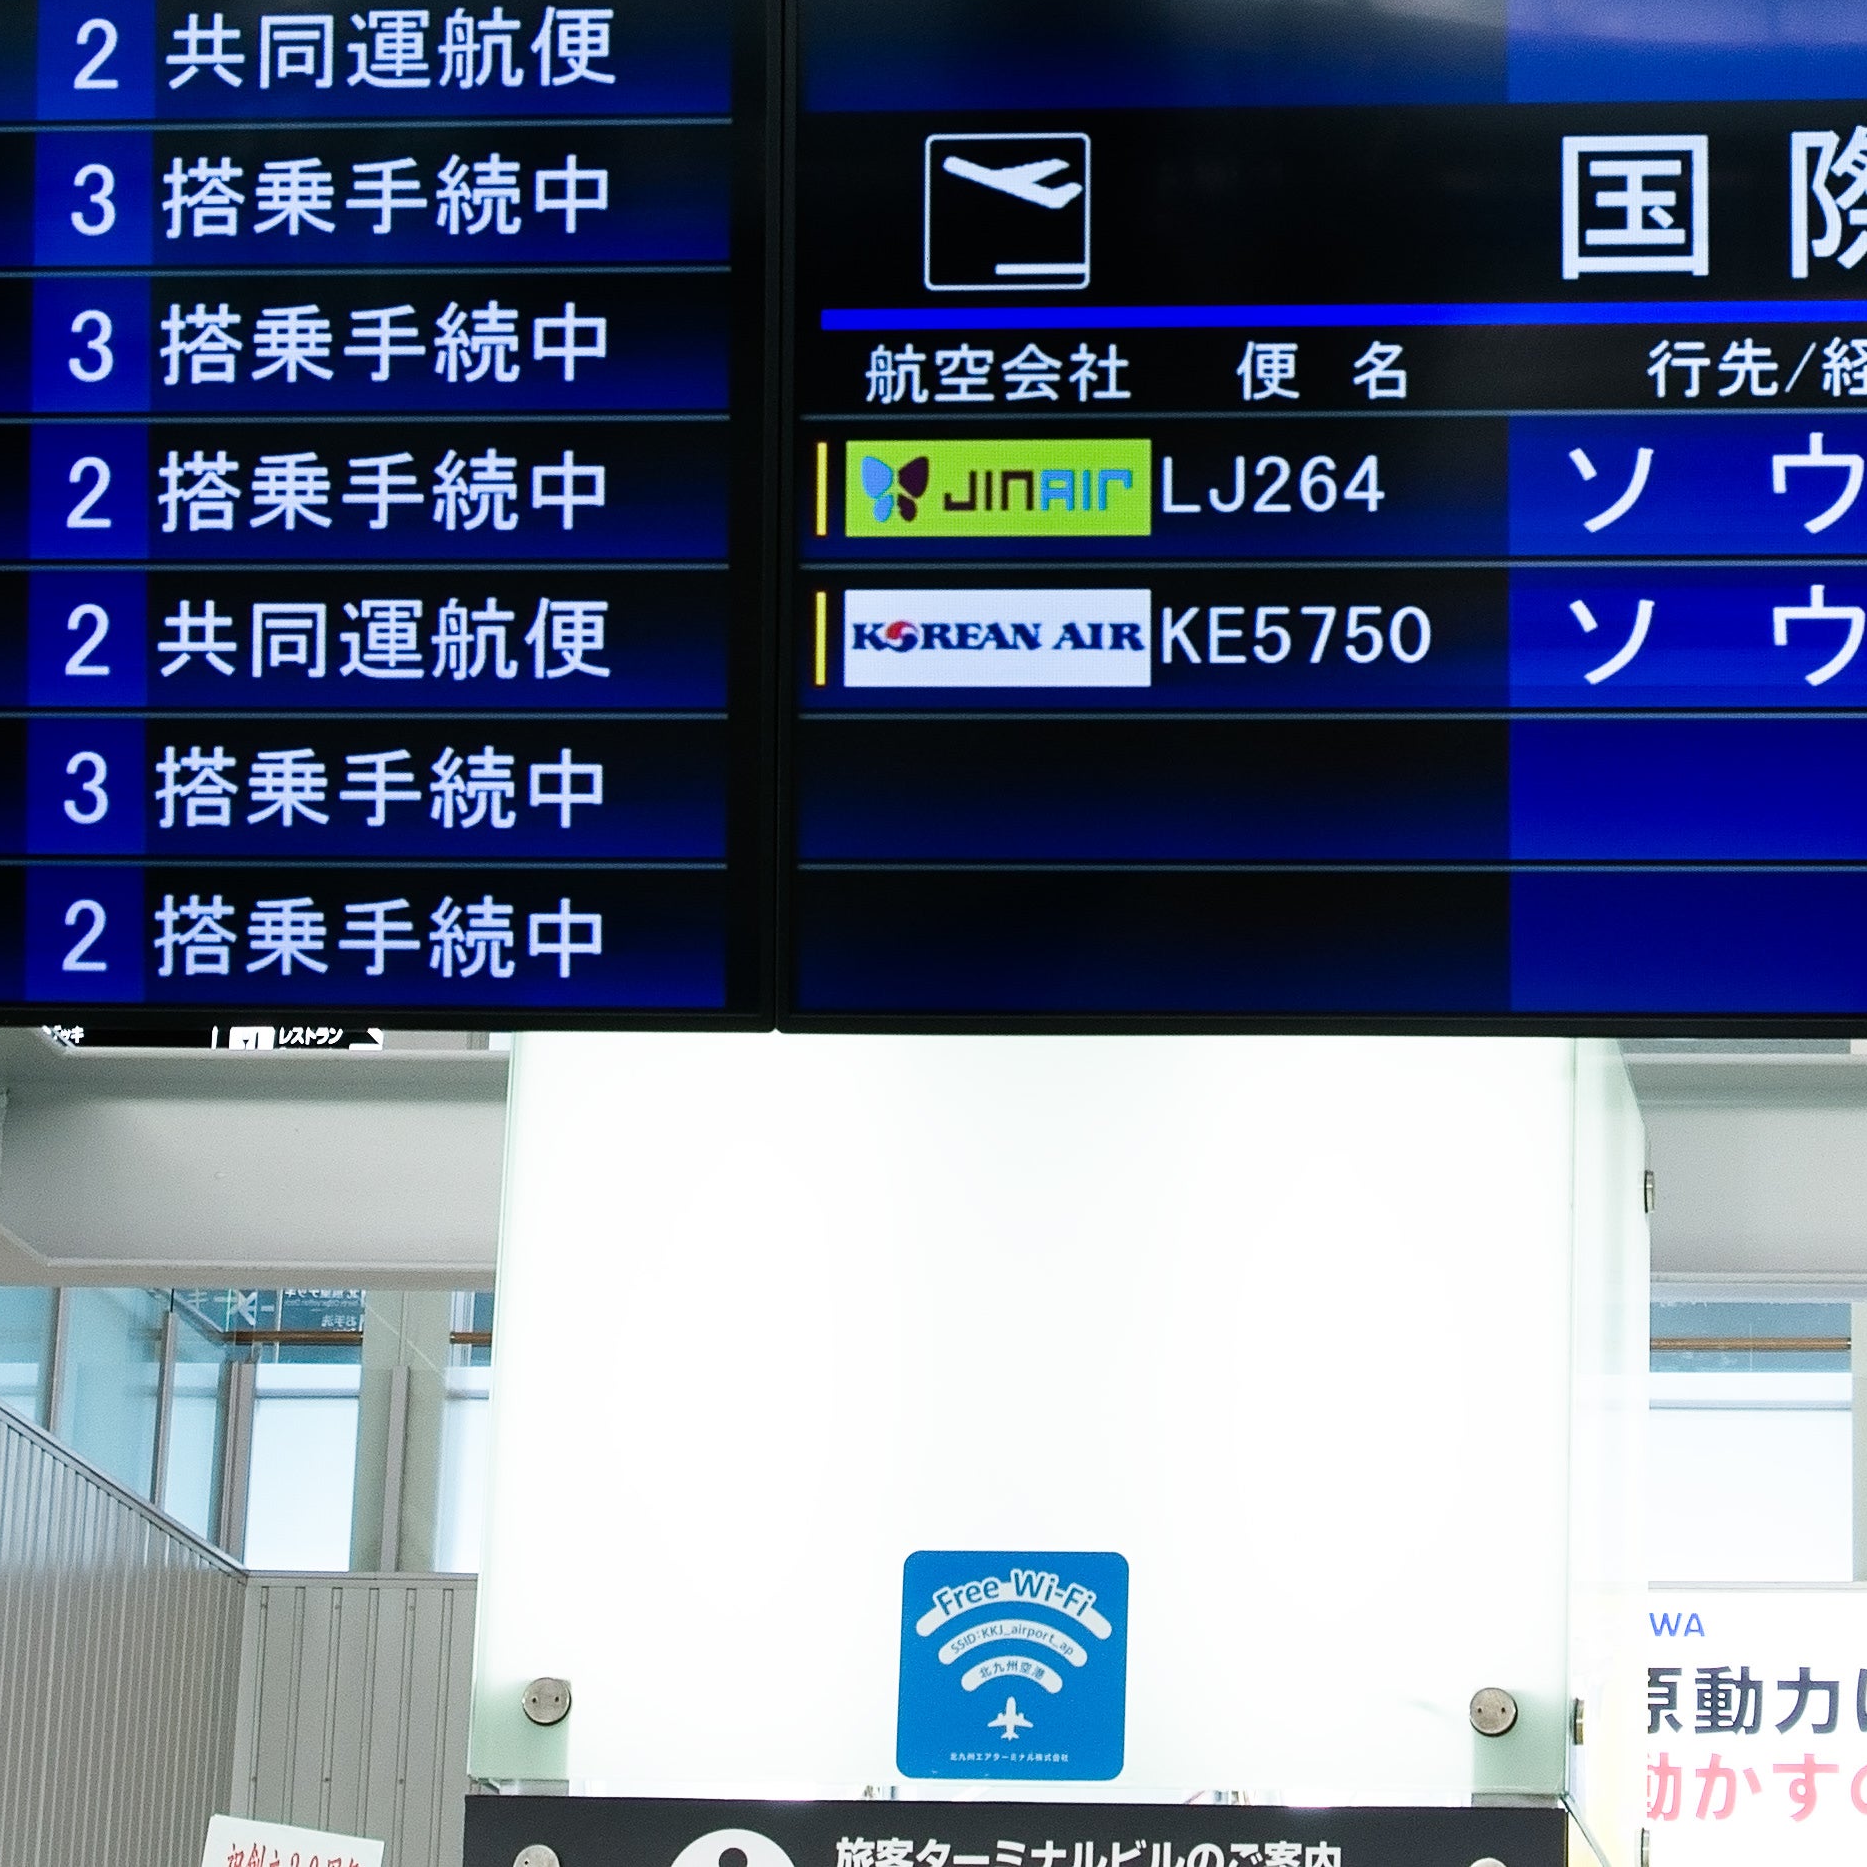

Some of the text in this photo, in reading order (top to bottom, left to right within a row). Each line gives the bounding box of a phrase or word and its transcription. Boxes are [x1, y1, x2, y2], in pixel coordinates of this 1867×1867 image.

[73, 18, 119, 89] 2
[166, 6, 616, 89] 共同運航便
[71, 163, 116, 236] 3
[162, 152, 608, 239] 搭乗手続中
[68, 309, 113, 382] 3
[160, 300, 607, 385] 搭乗手続中
[865, 342, 1131, 404] 航空会社
[1237, 340, 1407, 401] 便名
[66, 456, 111, 528] 2
[158, 448, 605, 533] 搭乗手続中
[1163, 455, 1385, 513] LJ264
[65, 603, 110, 676] 2
[157, 597, 610, 681] 共同運航便
[851, 620, 1041, 654] KOREAN
[1055, 622, 1145, 652] AIR
[1163, 606, 1431, 664] KE5750
[64, 751, 108, 824] 3
[155, 745, 603, 829] 搭乗手続中
[62, 899, 107, 971] 2
[154, 894, 602, 978] 搭乗手続中
[278, 1027, 344, 1045] レストラン
[936, 1571, 1094, 1617] Free Wi-Fi
[979, 1660, 1046, 1681] 北九州空港
[835, 1836, 1342, 1867] 旅客ターミナルビルのご案内
